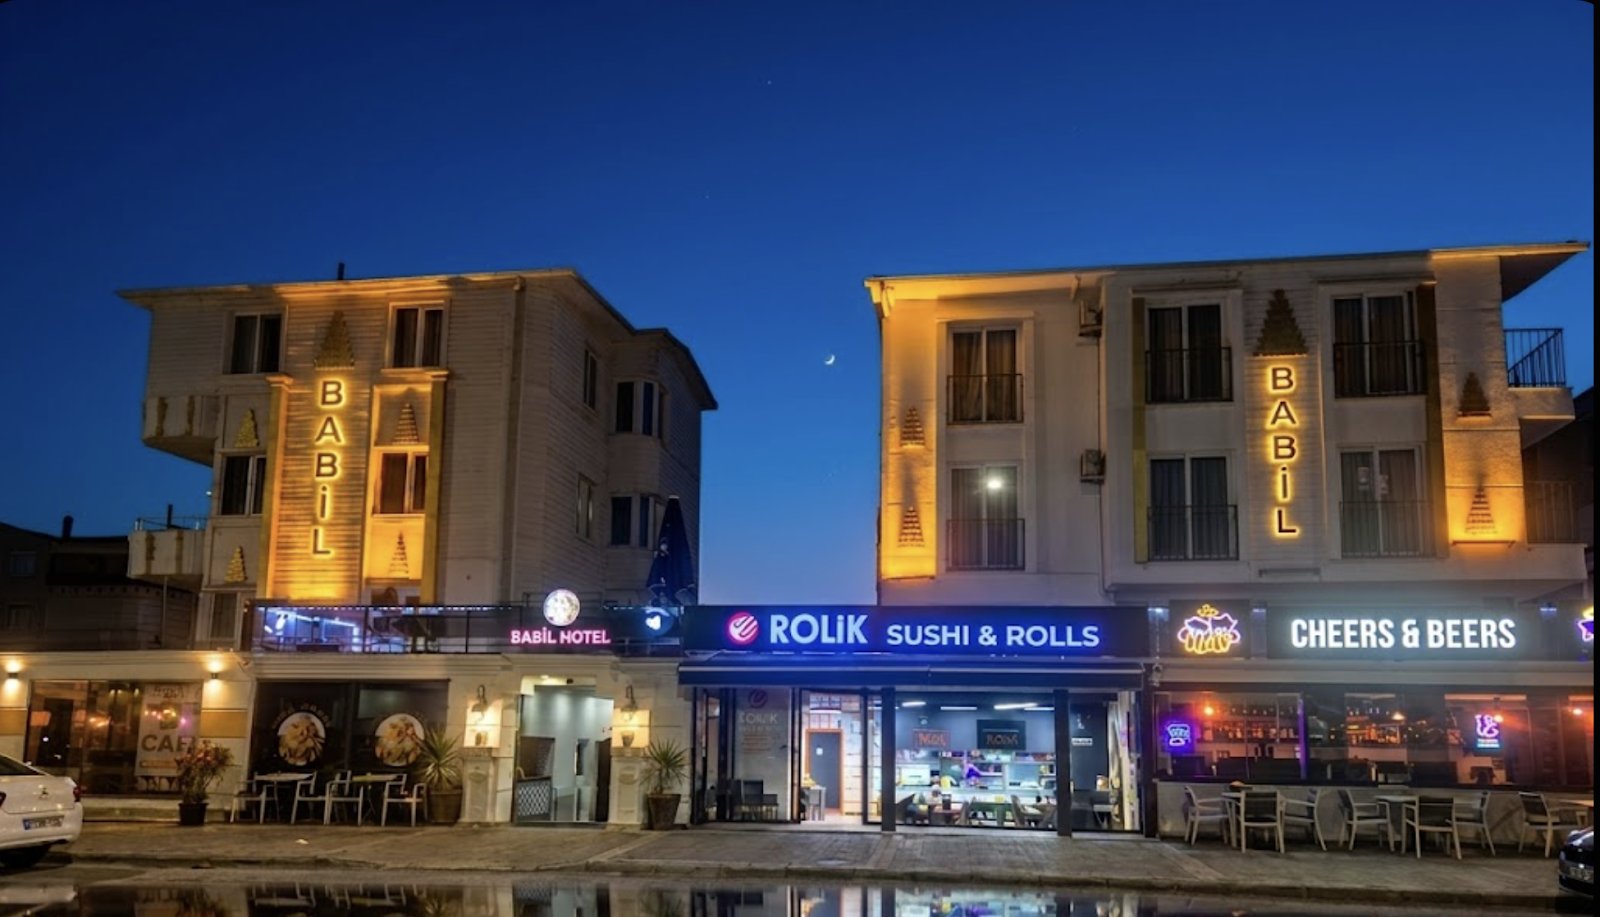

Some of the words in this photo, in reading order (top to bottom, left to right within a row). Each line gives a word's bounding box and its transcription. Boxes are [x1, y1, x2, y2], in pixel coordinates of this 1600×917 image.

[559, 629, 612, 645] HOTEL
[887, 625, 969, 645] SUSHI
[978, 625, 997, 646] &
[1006, 626, 1100, 647] ROLLS
[1290, 618, 1396, 649] CHEERS
[1401, 618, 1420, 649] &
[1426, 618, 1517, 649] BEERS
